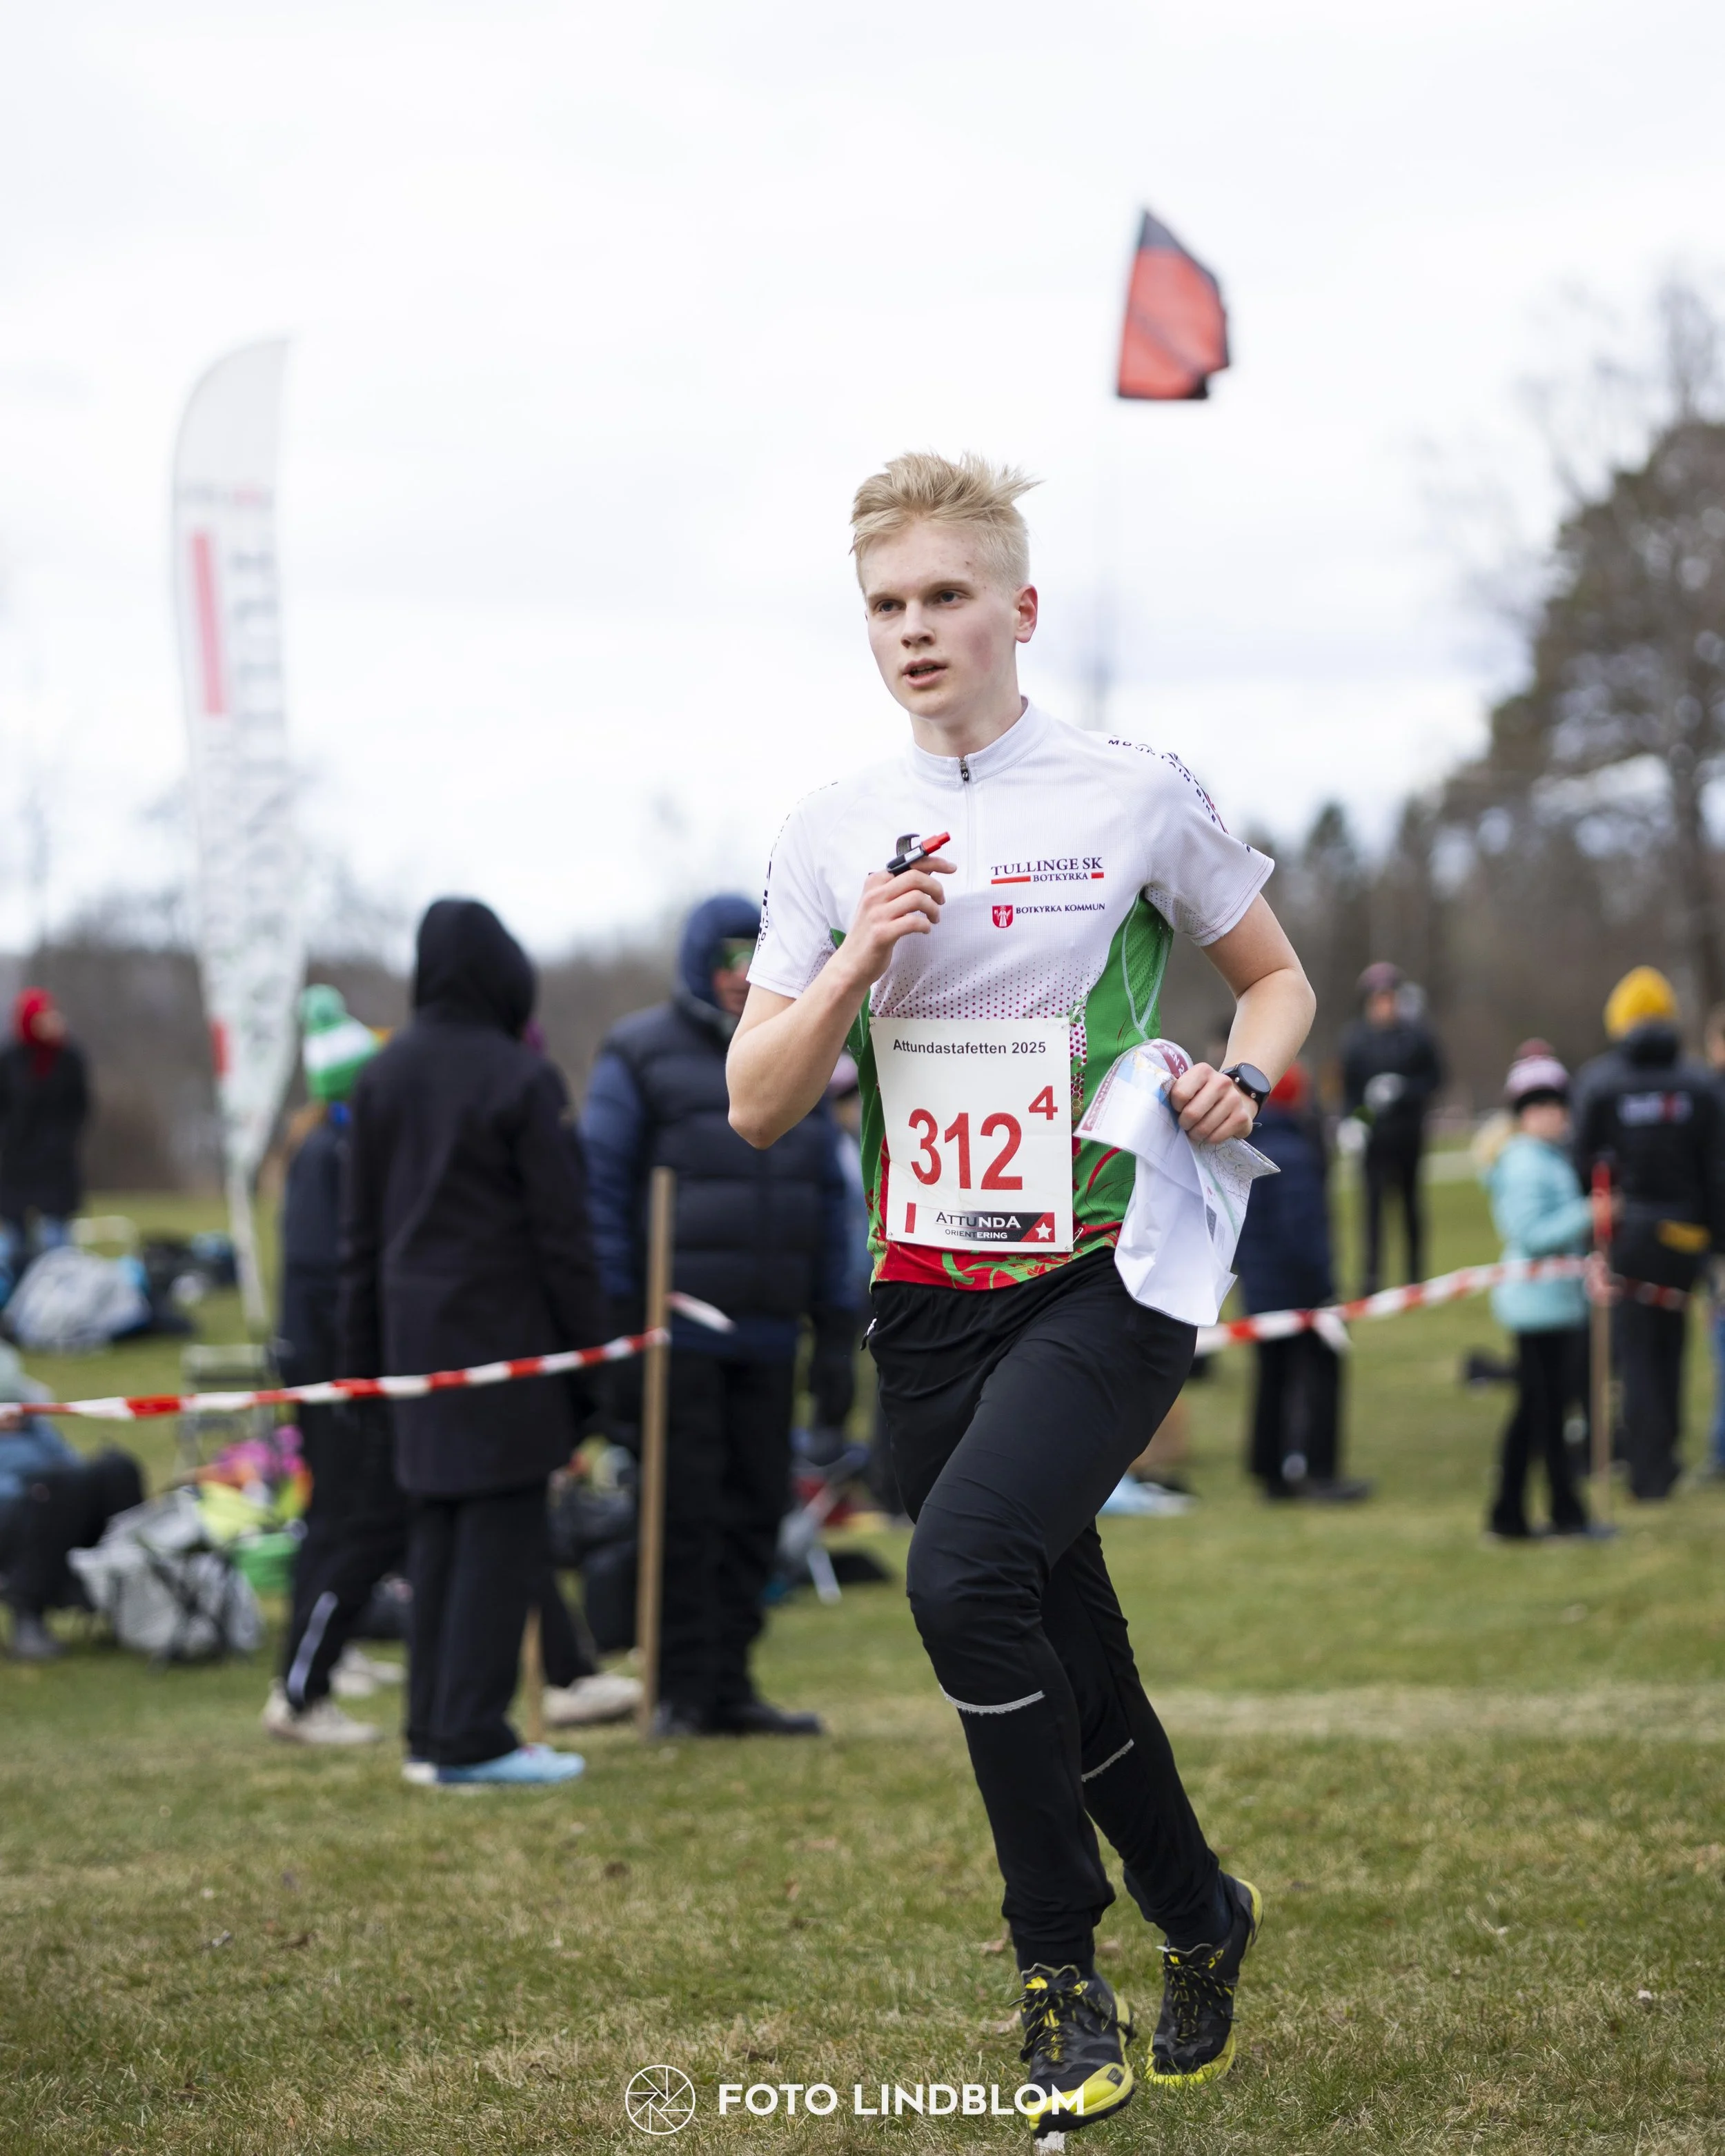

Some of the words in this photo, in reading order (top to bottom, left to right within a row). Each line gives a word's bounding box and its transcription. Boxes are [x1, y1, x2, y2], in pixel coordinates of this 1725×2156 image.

[991, 858, 1078, 876] TULLINGE
[1082, 857, 1103, 870] SK
[1033, 872, 1088, 882] BOTKYRKA
[1016, 904, 1062, 914] BOTKYRKA
[1065, 902, 1105, 912] KOMMUN
[893, 1039, 1006, 1054] Attundastafetten
[1012, 1041, 1046, 1054] 2025
[1028, 1085, 1058, 1120] 4
[908, 1108, 1023, 1189] 312
[936, 1211, 1021, 1228] ATTUNDA
[945, 1229, 1008, 1239] ORIENTERING
